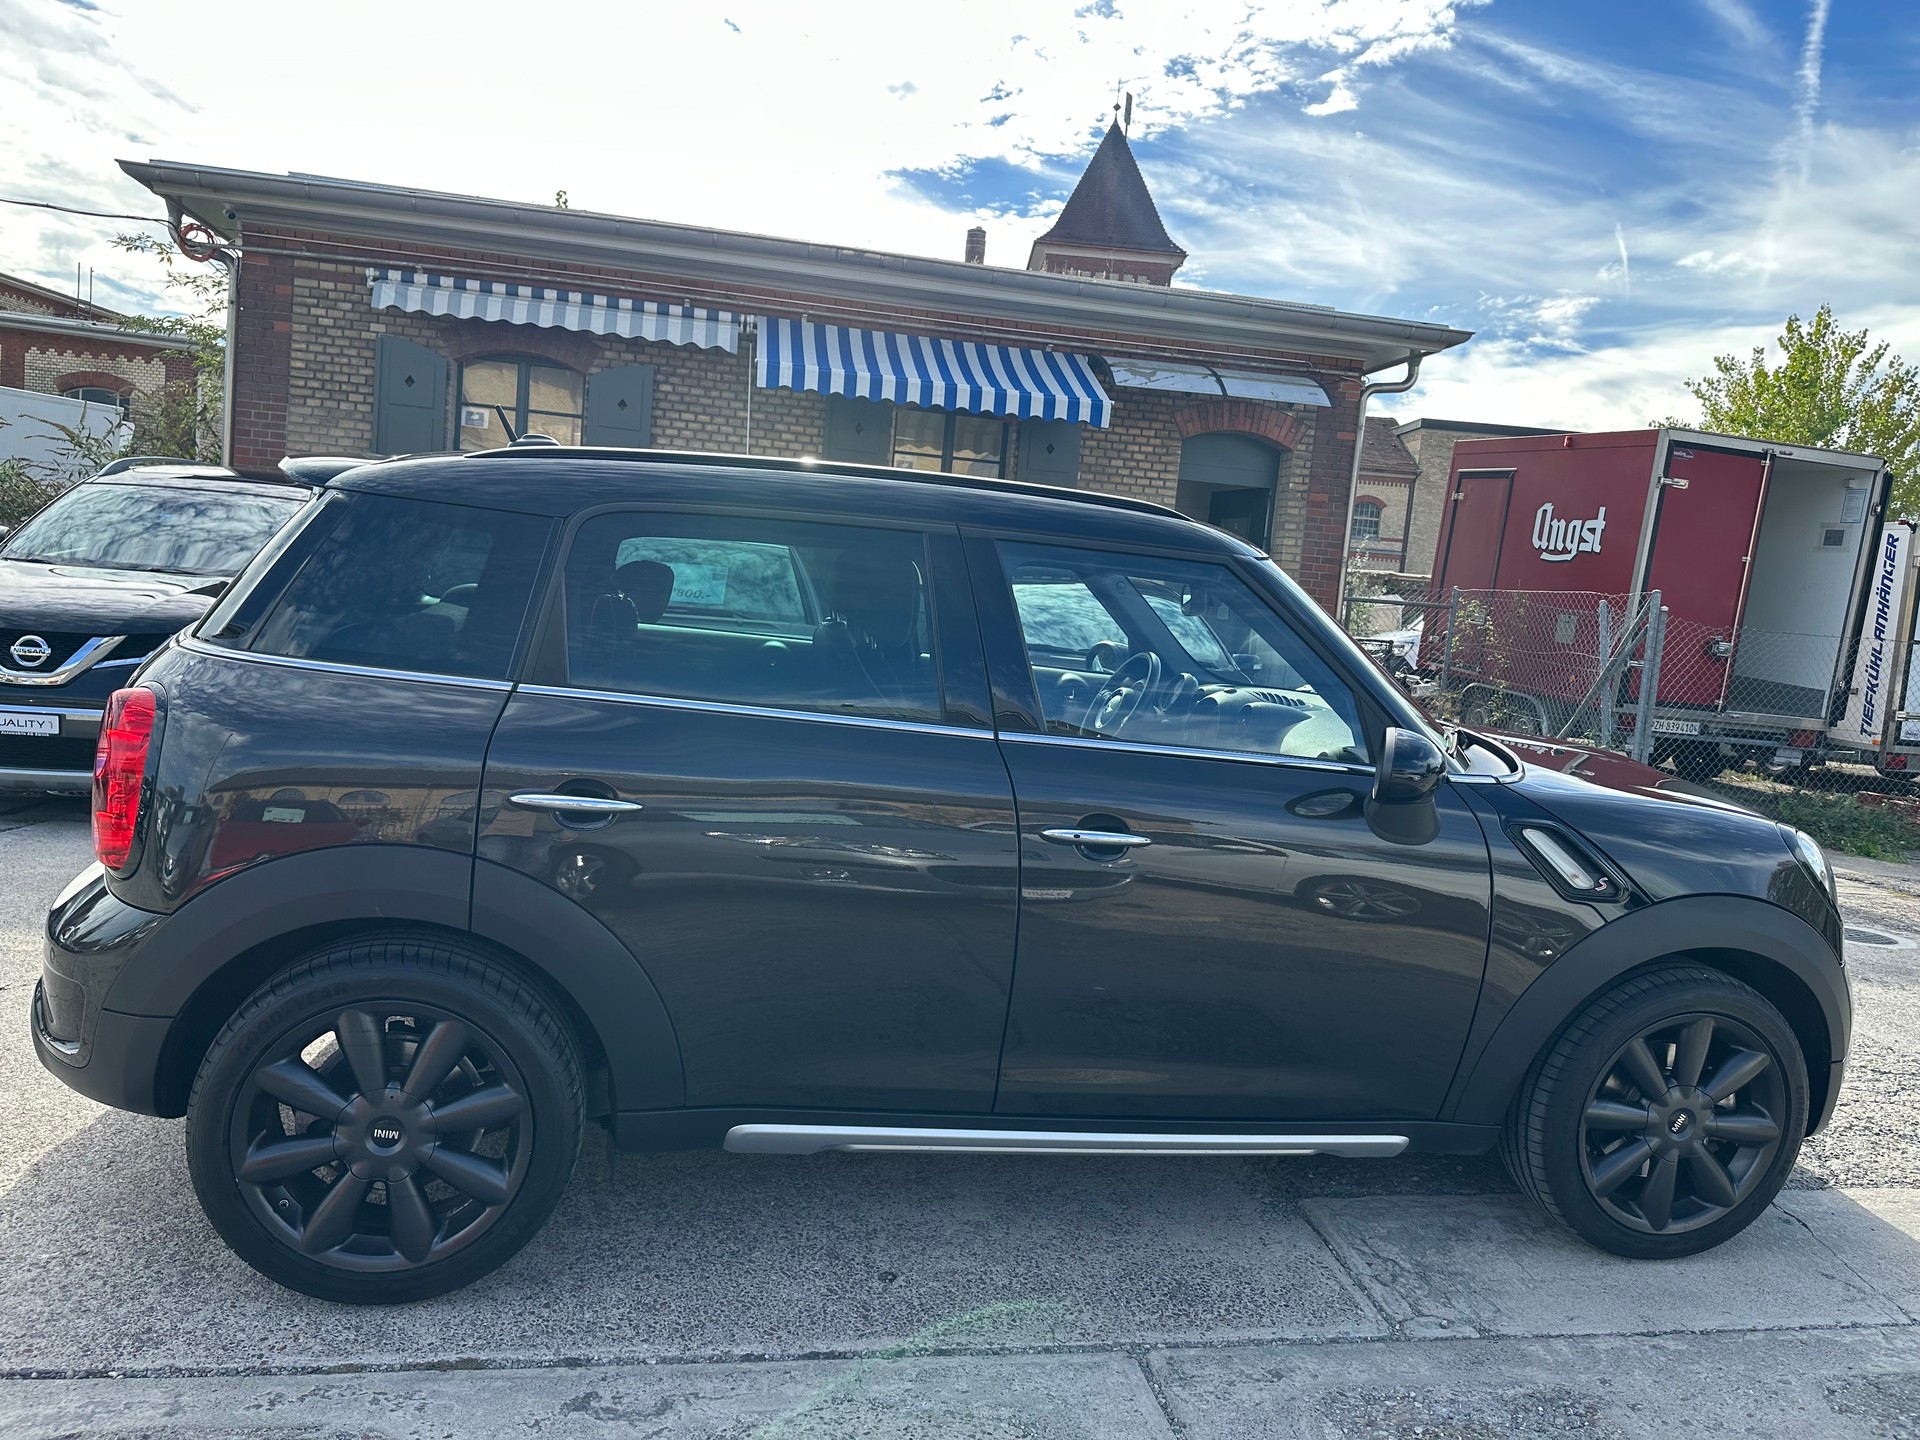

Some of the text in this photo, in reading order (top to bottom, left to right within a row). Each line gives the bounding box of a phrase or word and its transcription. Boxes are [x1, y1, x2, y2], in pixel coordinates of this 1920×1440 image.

[1532, 503, 1606, 561] Angst
[673, 588, 711, 599] '800.-
[1860, 533, 1900, 737] TIEFKÜHLANHÄNGER
[13, 647, 46, 655] NISSAN
[0, 718, 45, 729] UALITY
[1595, 877, 1608, 891] S
[1671, 1113, 1687, 1132] MINI
[373, 1128, 399, 1139] MINI
